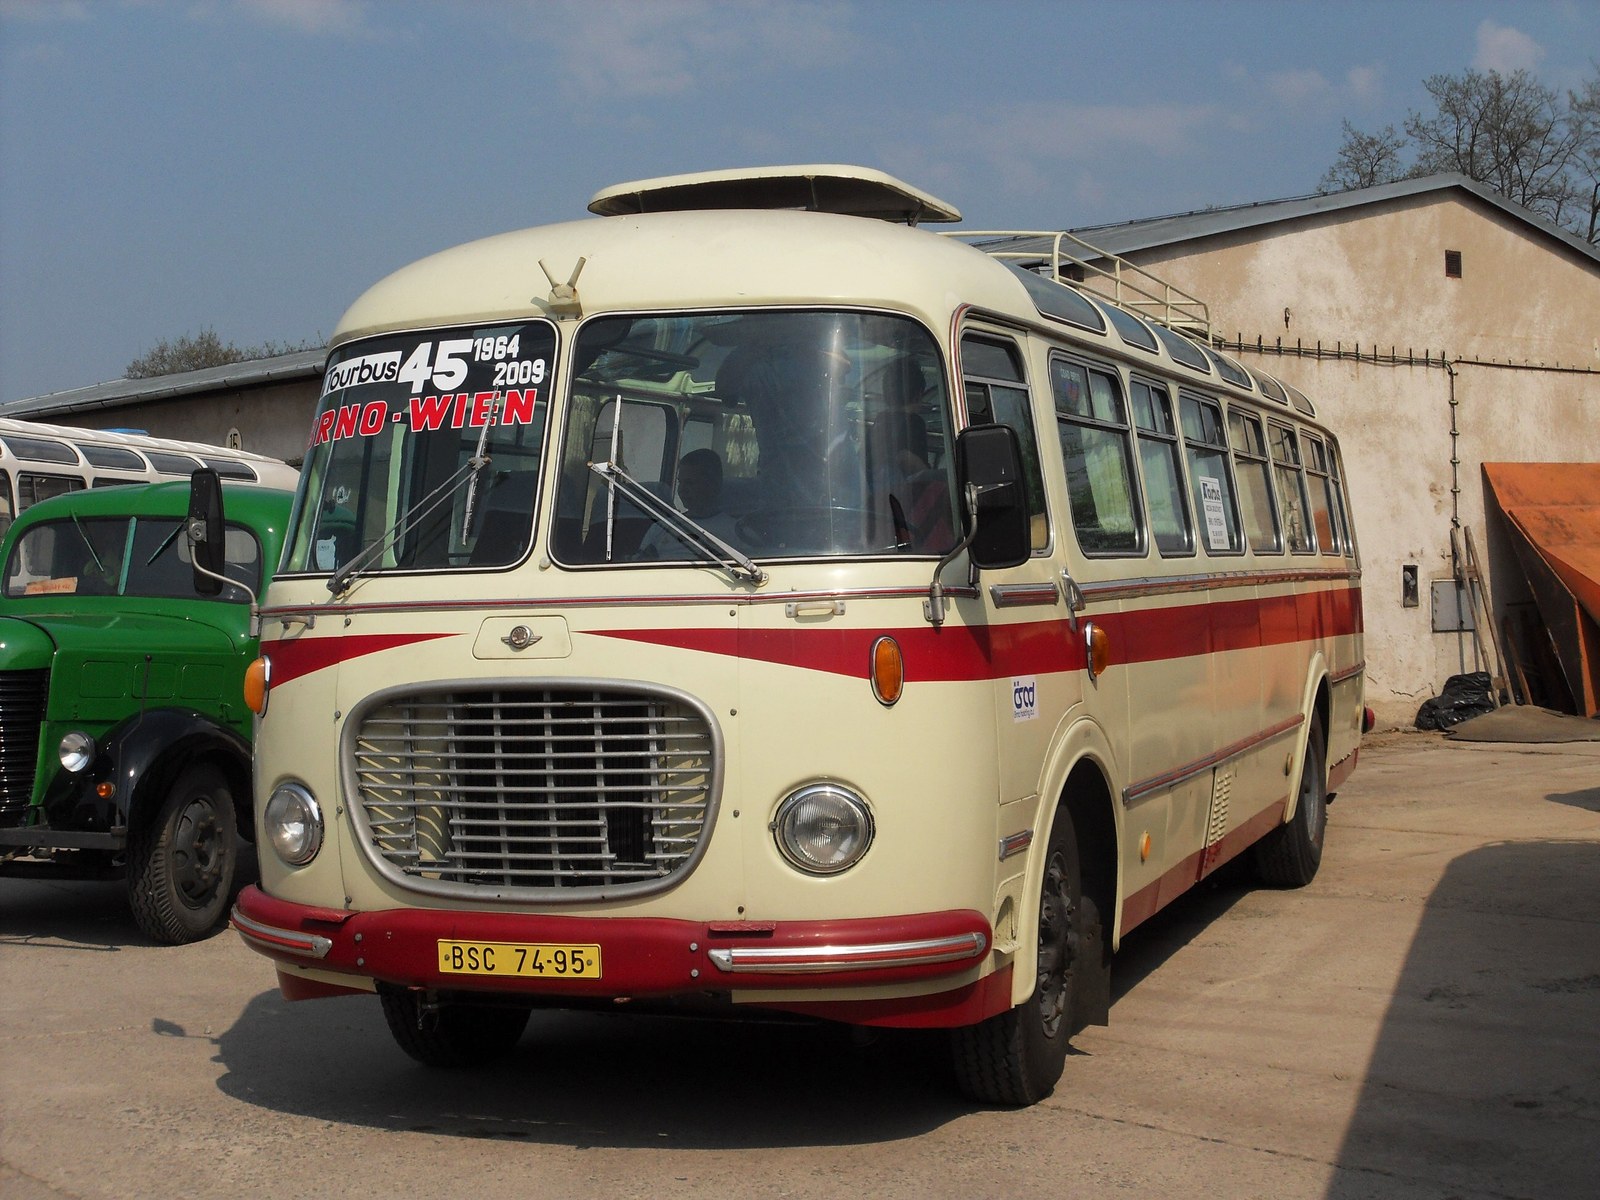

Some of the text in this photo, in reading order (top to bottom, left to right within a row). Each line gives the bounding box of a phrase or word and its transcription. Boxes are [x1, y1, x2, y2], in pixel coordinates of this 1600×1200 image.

[473, 334, 520, 361] 1964
[398, 338, 474, 394] 45
[493, 358, 546, 386] 2009
[409, 388, 537, 433] WIEN
[452, 945, 585, 974] BSC 74-95
